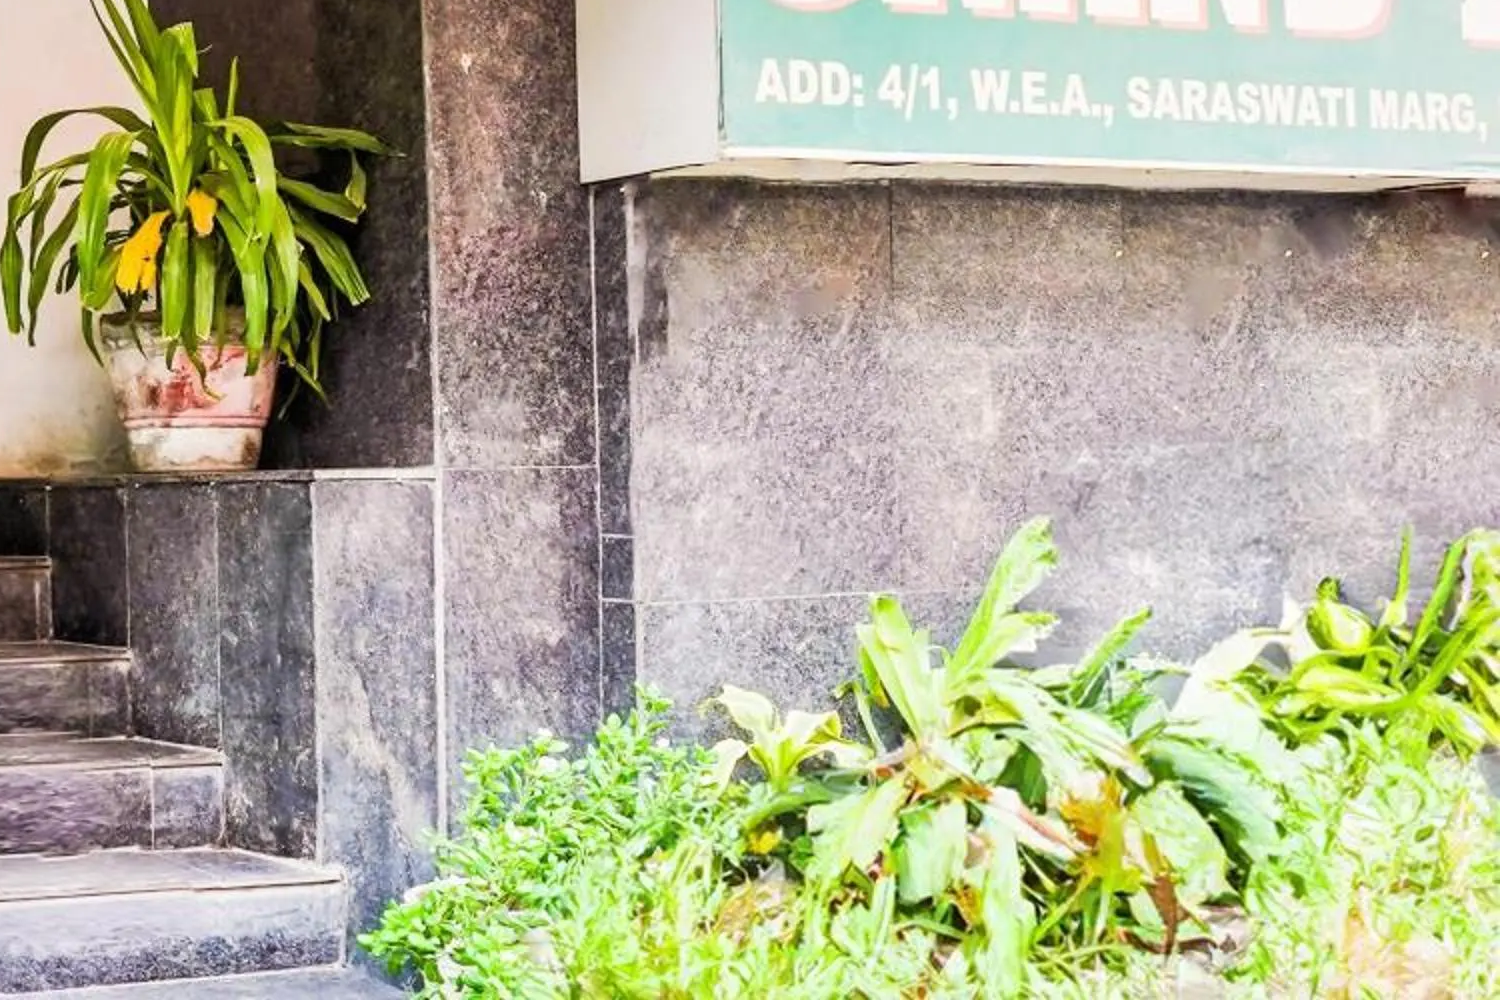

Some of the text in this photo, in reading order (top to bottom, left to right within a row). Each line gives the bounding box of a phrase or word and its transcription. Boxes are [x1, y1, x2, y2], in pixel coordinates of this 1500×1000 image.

[755, 58, 1488, 144] ADD: 4/1, W.E.A., SARASWATI MARG,
